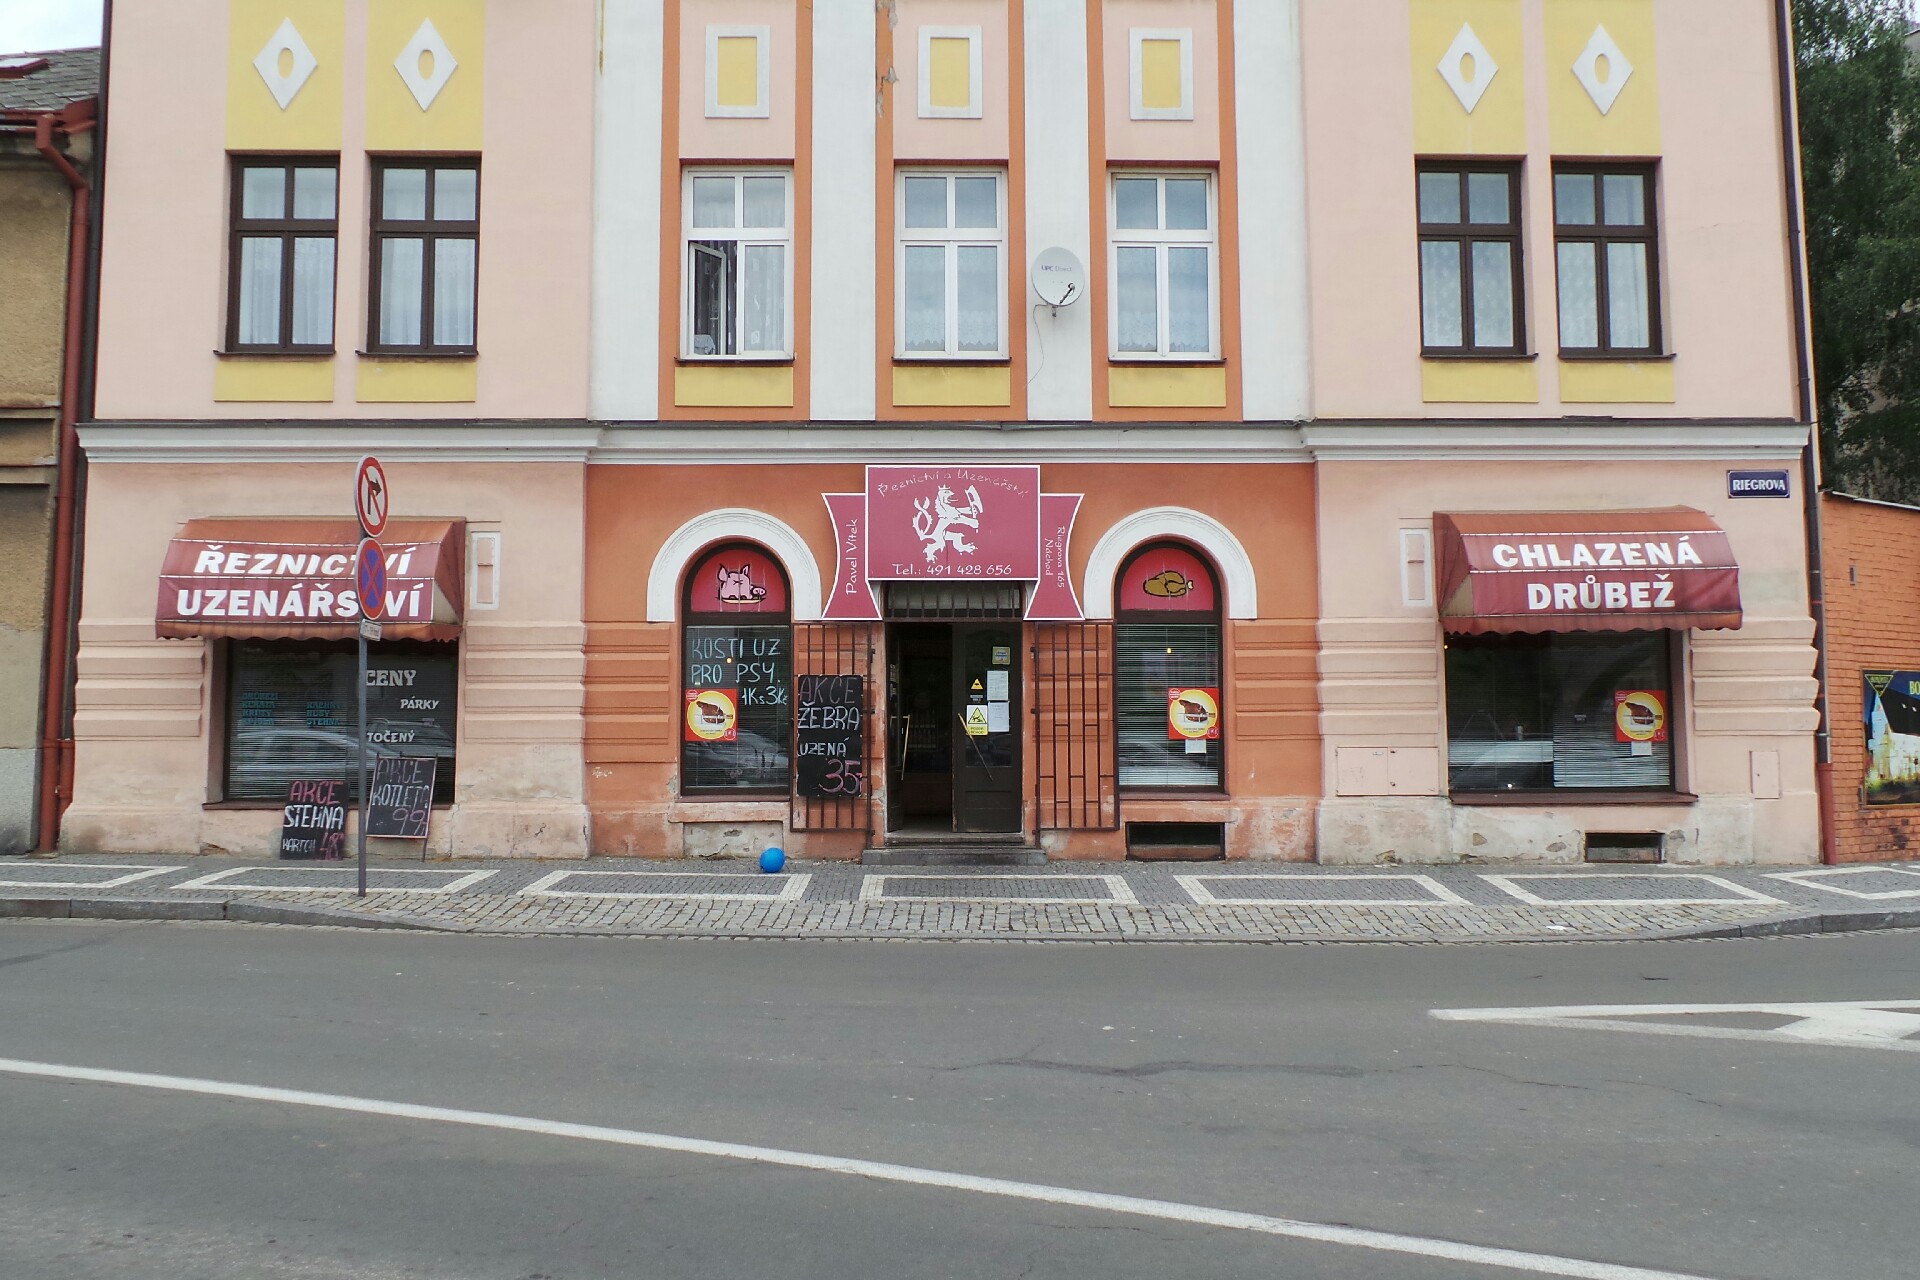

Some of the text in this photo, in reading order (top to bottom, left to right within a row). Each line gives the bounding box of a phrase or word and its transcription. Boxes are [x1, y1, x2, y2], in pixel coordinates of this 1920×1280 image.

[943, 471, 952, 479] a
[1732, 479, 1786, 491] RIEGROVA
[845, 518, 858, 596] Pavel Vítek
[1045, 538, 1054, 576] Náchod
[1055, 525, 1066, 588] Riegrova 165
[1491, 535, 1703, 568] CHLAZENÁ
[891, 563, 1012, 576] Tel.: 491 428 656
[176, 582, 425, 618] UZENÁŘSVÍ
[1527, 574, 1676, 610] DRŮBEŽ
[691, 637, 744, 660] KOSTI
[366, 669, 417, 687] CENY
[691, 664, 723, 684] PRO
[400, 696, 439, 710] PÁRKY
[799, 677, 858, 704] AKCE
[798, 701, 861, 731] ŽEBRA
[366, 729, 416, 743] TOČENÝ
[799, 736, 850, 757] UZENÁ
[377, 759, 429, 784] AKCE
[289, 780, 344, 805] AKCE
[283, 804, 344, 830] STEHNA
